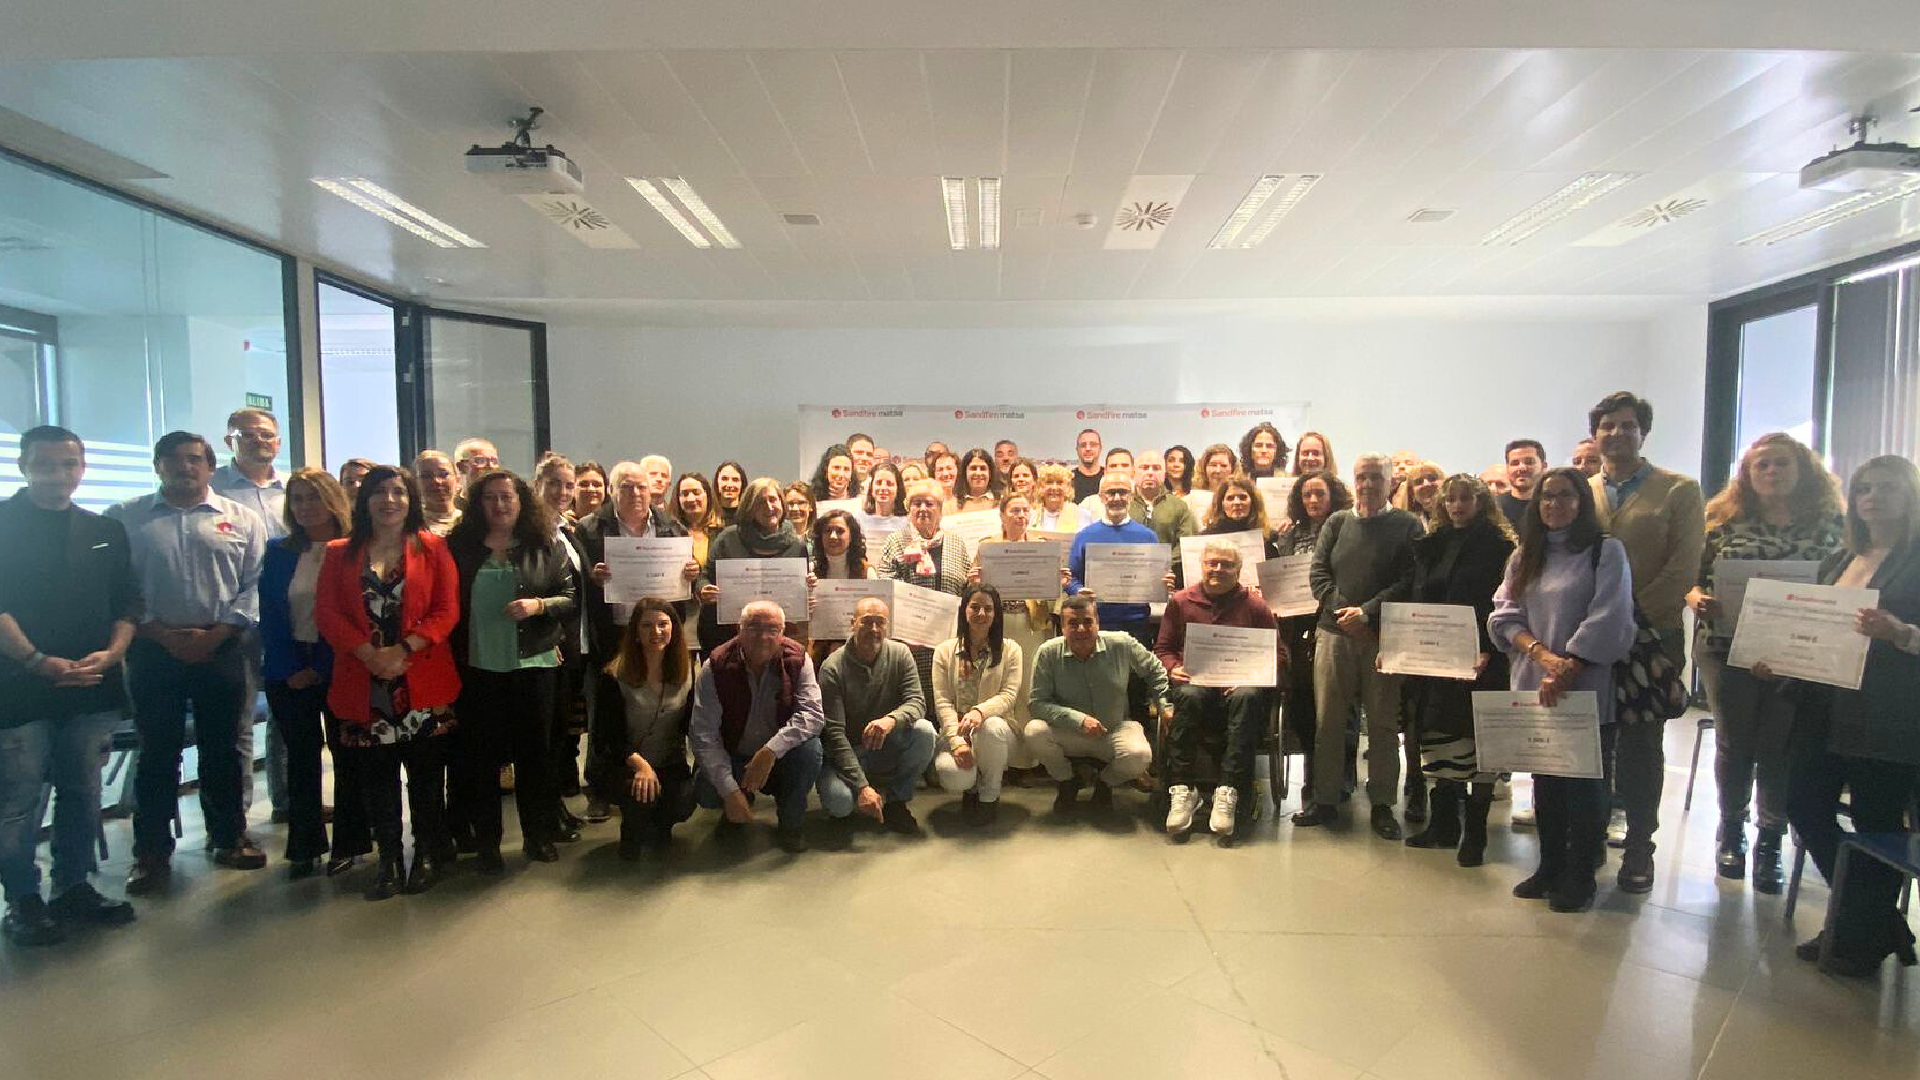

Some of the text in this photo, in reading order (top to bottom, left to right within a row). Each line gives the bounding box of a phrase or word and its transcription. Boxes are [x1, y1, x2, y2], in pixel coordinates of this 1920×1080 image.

[843, 409, 904, 418] Sandfire matsa
[964, 410, 1025, 419] Sandfire matsa
[1086, 410, 1147, 419] Sandfire matsa
[1211, 407, 1273, 418] Sandfire matsa
